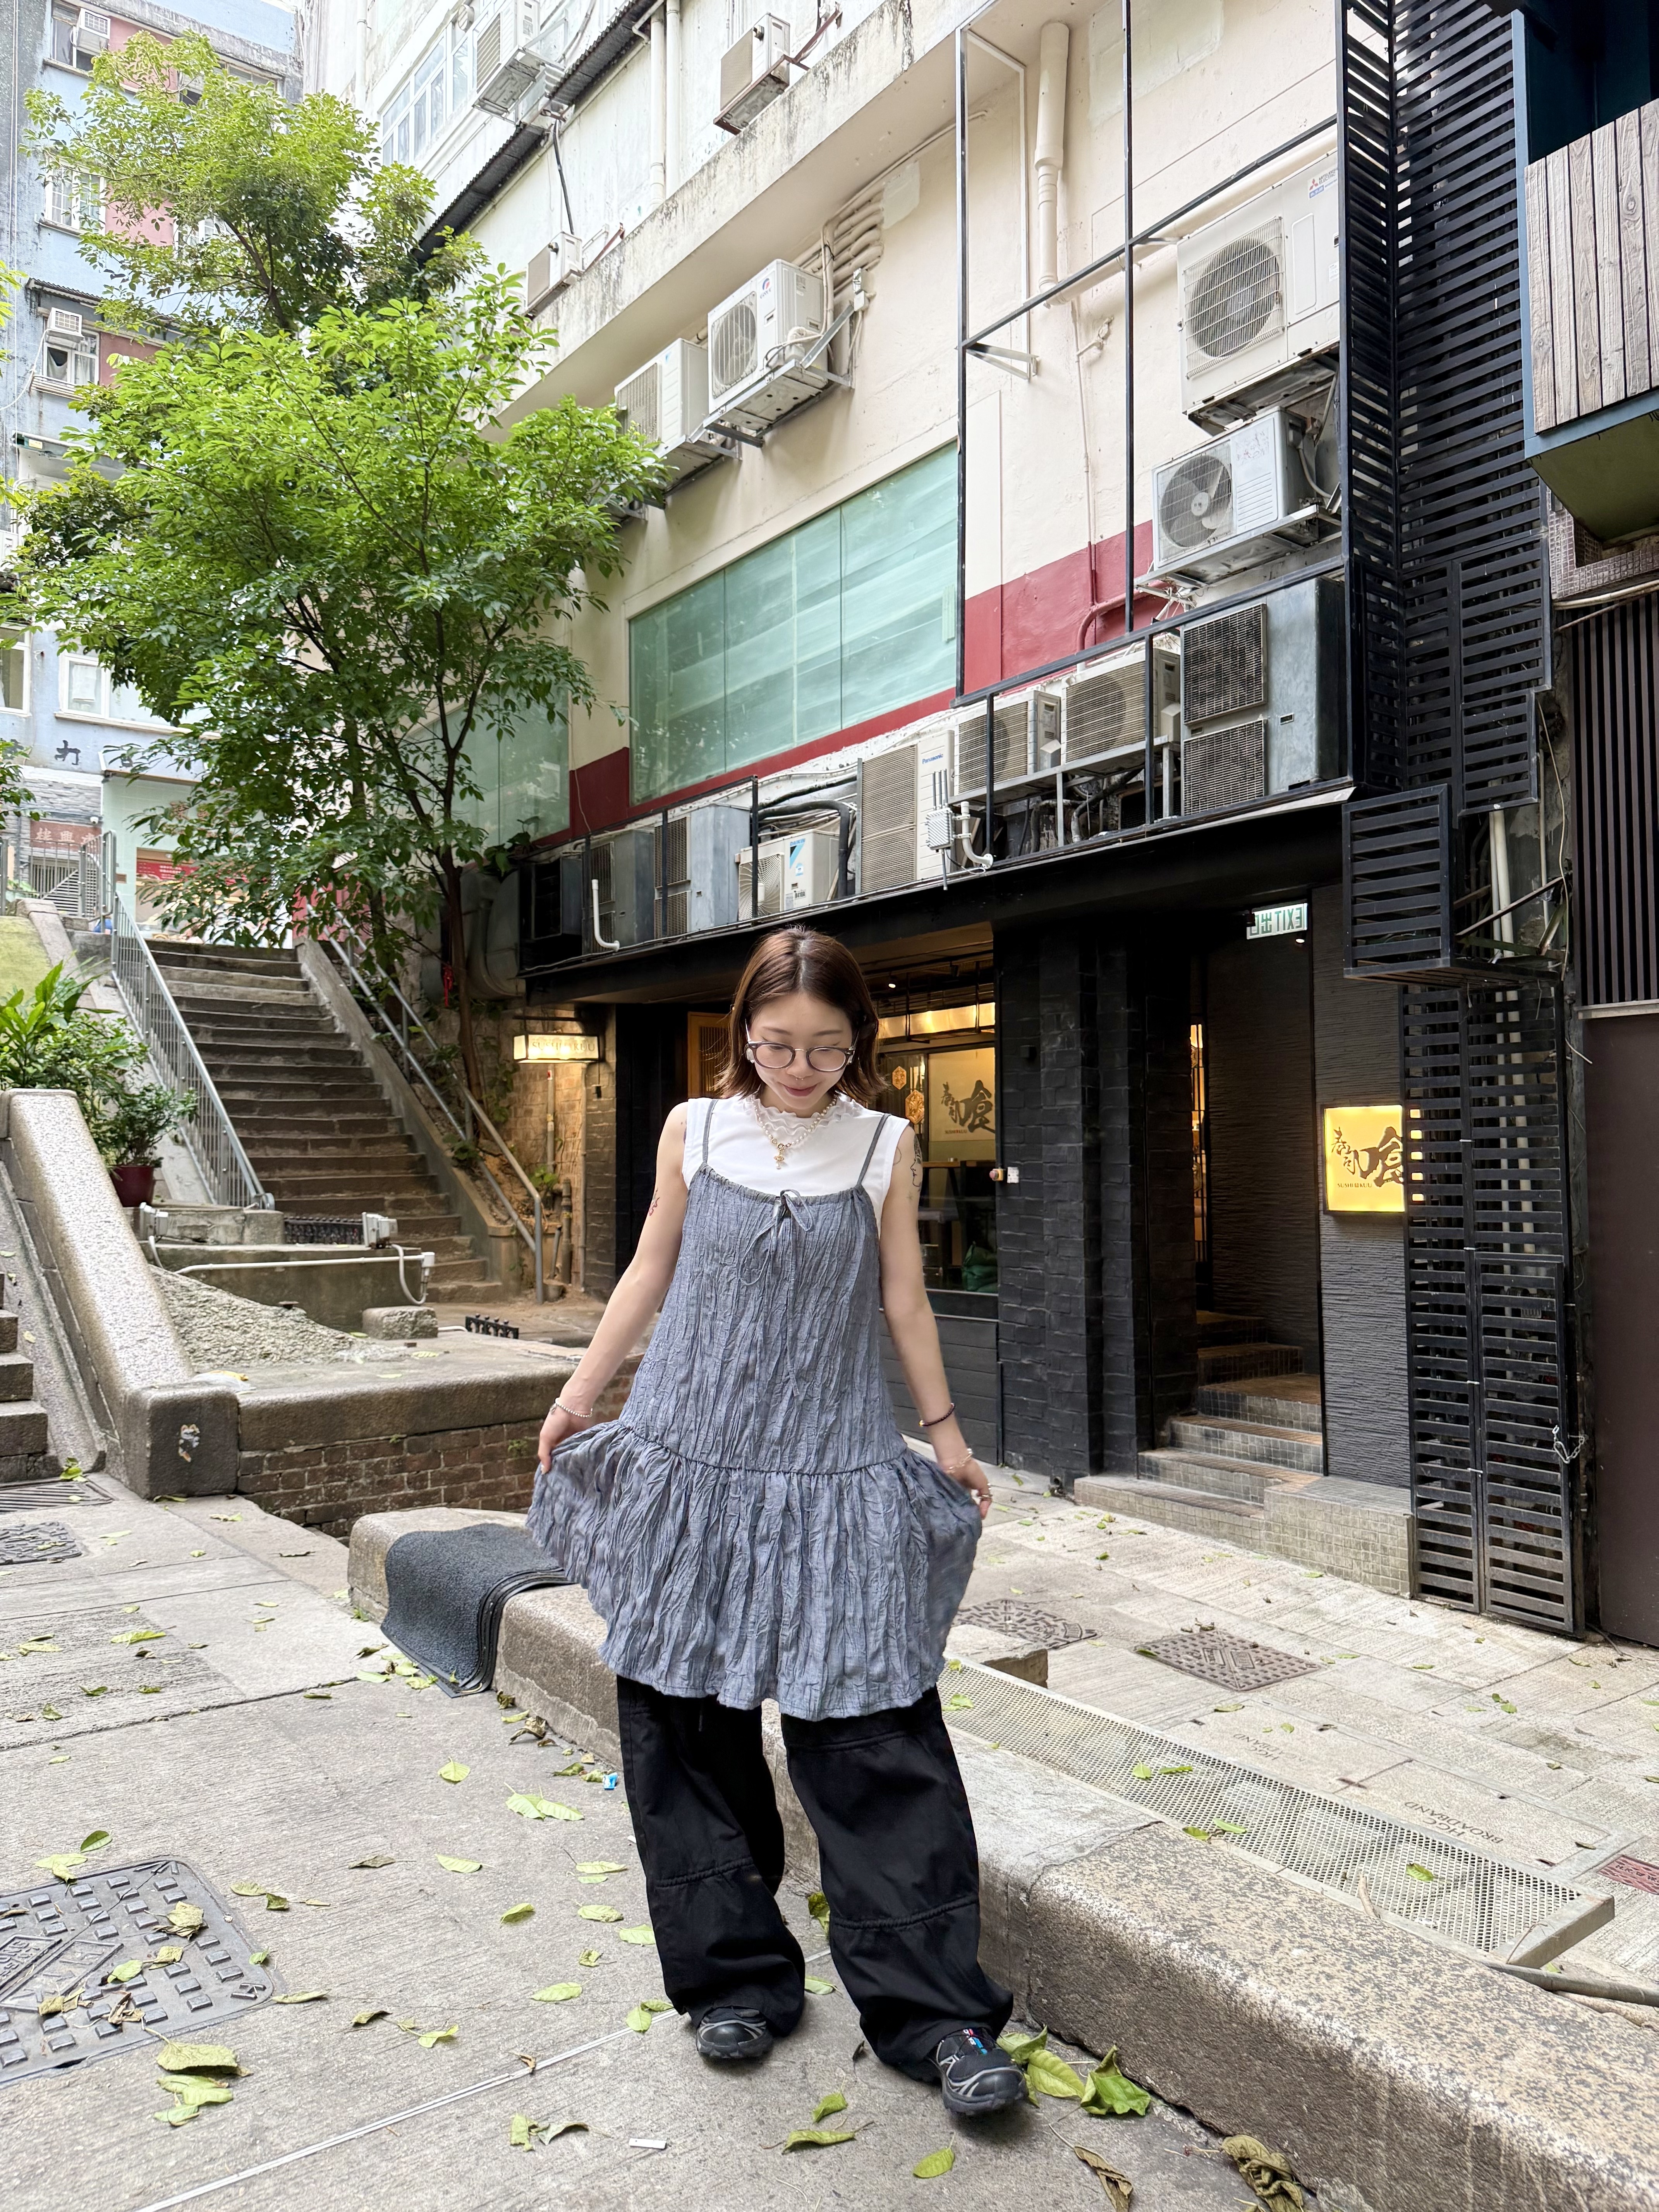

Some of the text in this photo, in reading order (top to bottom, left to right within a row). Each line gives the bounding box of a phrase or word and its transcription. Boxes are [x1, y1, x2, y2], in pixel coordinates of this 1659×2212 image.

[922, 753, 944, 764] Panasonic
[790, 838, 805, 846] DAIKIN
[574, 1043, 595, 1051] KUU
[1405, 1802, 1503, 1844] BROADBAND
[1422, 1817, 1465, 1837] HGC
